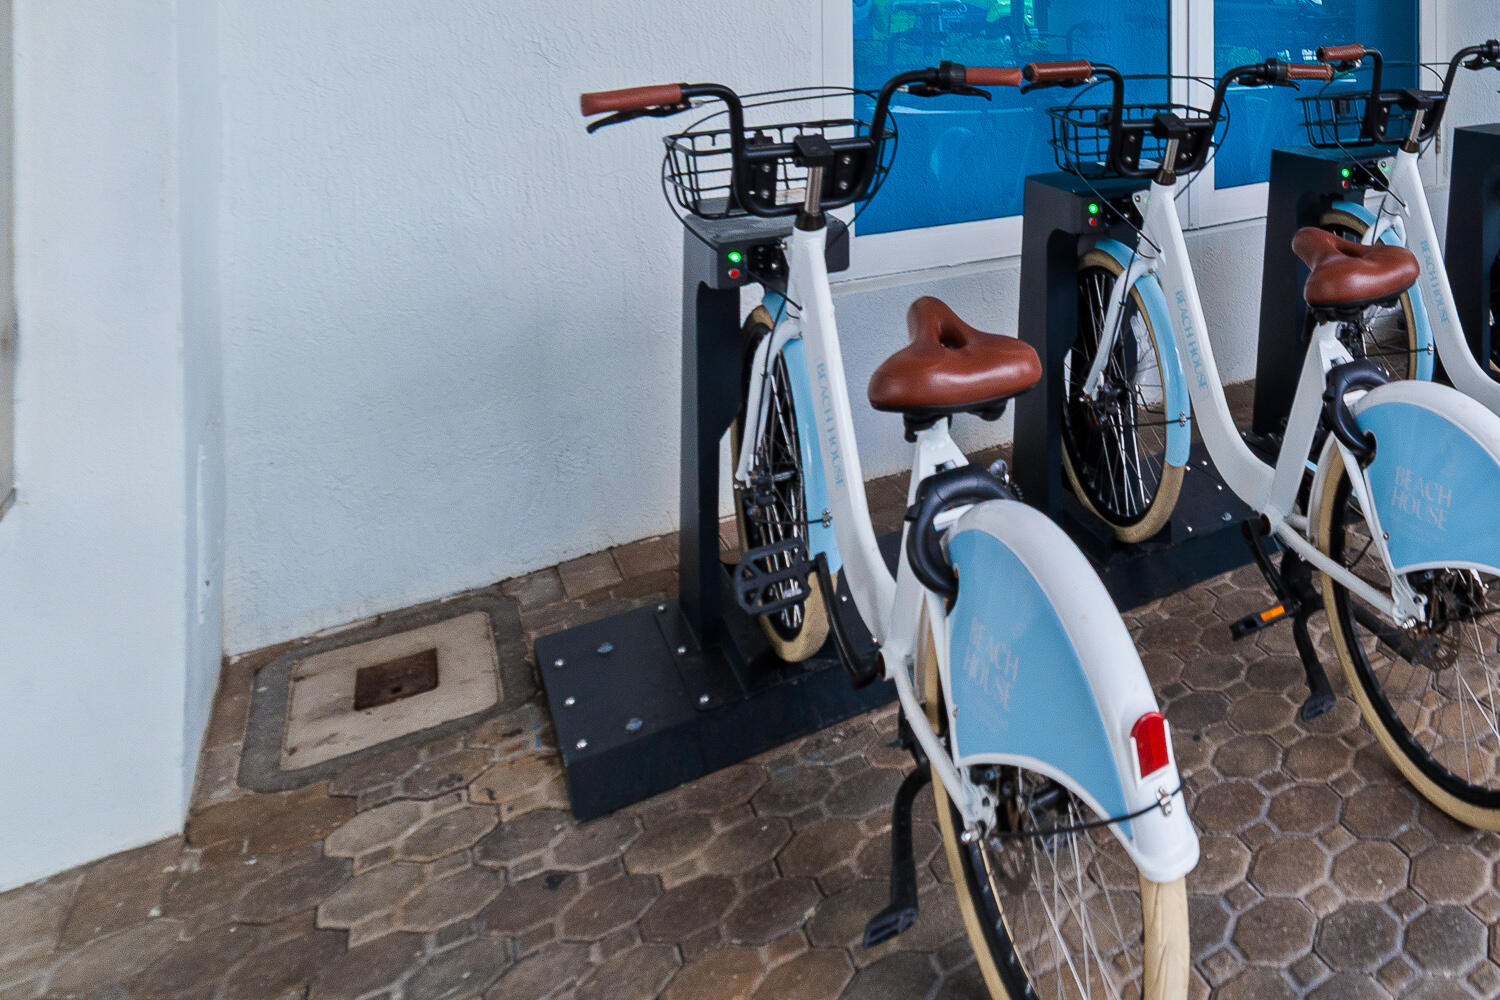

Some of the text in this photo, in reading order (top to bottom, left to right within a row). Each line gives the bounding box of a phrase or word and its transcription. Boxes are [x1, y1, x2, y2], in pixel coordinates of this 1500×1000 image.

[1420, 240, 1437, 280] BEACH
[1175, 289, 1194, 338] BEACH
[1188, 341, 1209, 390] HOUSE
[816, 361, 846, 488] BEACH HOUSE
[1391, 487, 1448, 531] HOUSE
[1394, 466, 1452, 508] BEACH
[962, 644, 1014, 712] HOUSE
[969, 616, 1019, 682] BEACH
